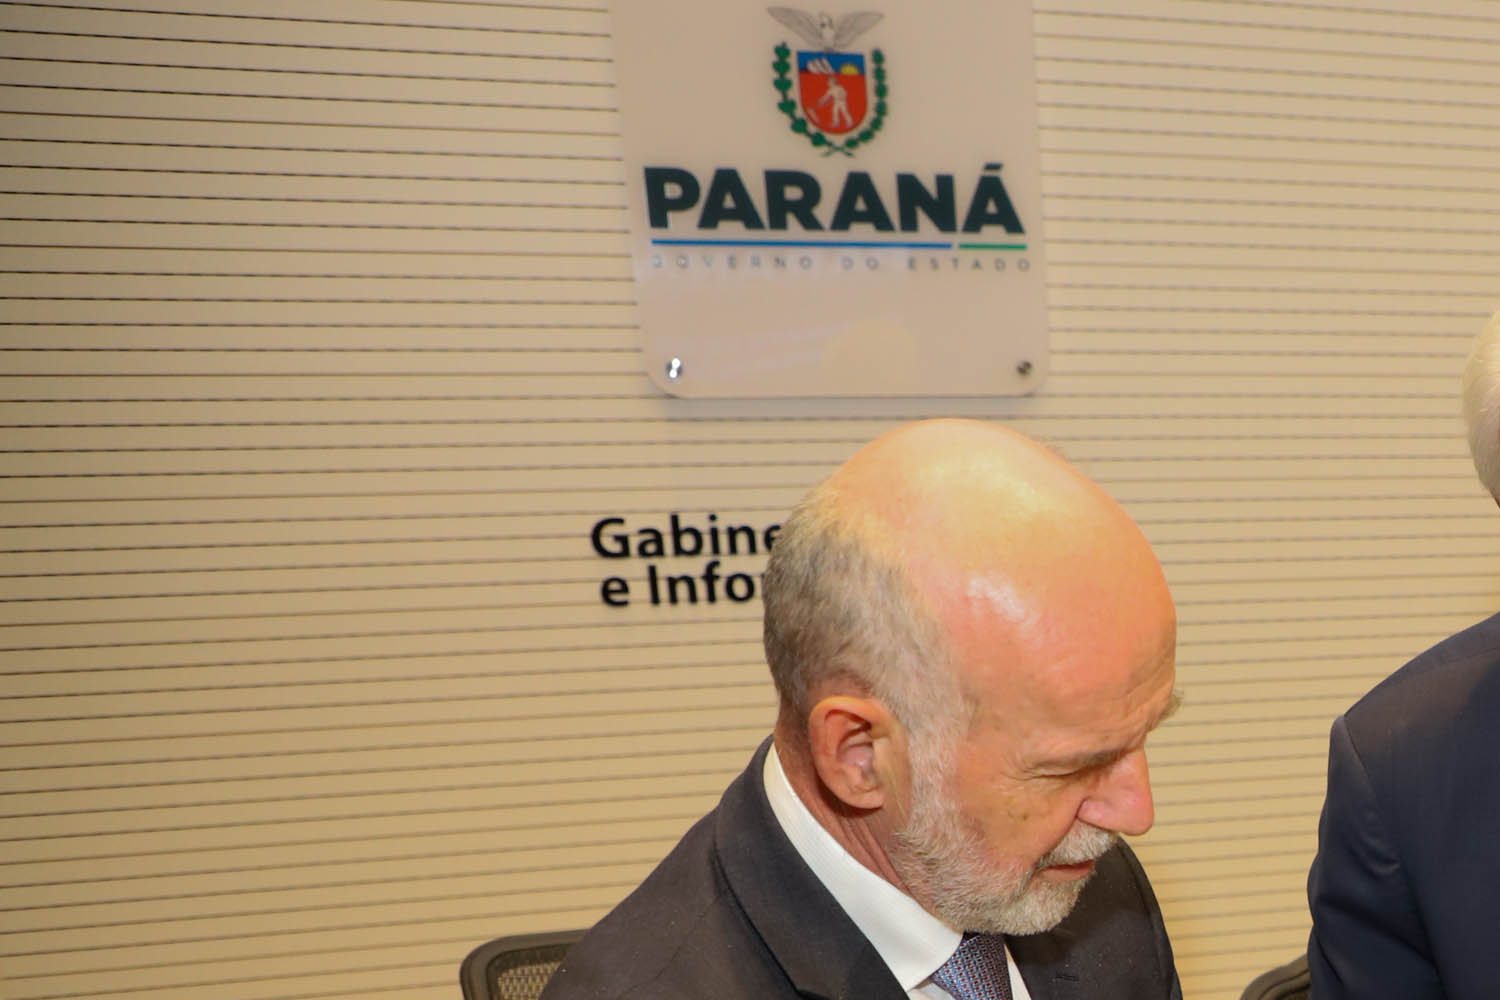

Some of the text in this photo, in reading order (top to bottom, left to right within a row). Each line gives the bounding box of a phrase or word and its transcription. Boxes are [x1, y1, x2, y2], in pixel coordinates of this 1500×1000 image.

[643, 162, 1026, 235] PARANÁ
[651, 254, 1031, 272] GOVERNO DO ESTADO
[601, 560, 762, 607] e Info
